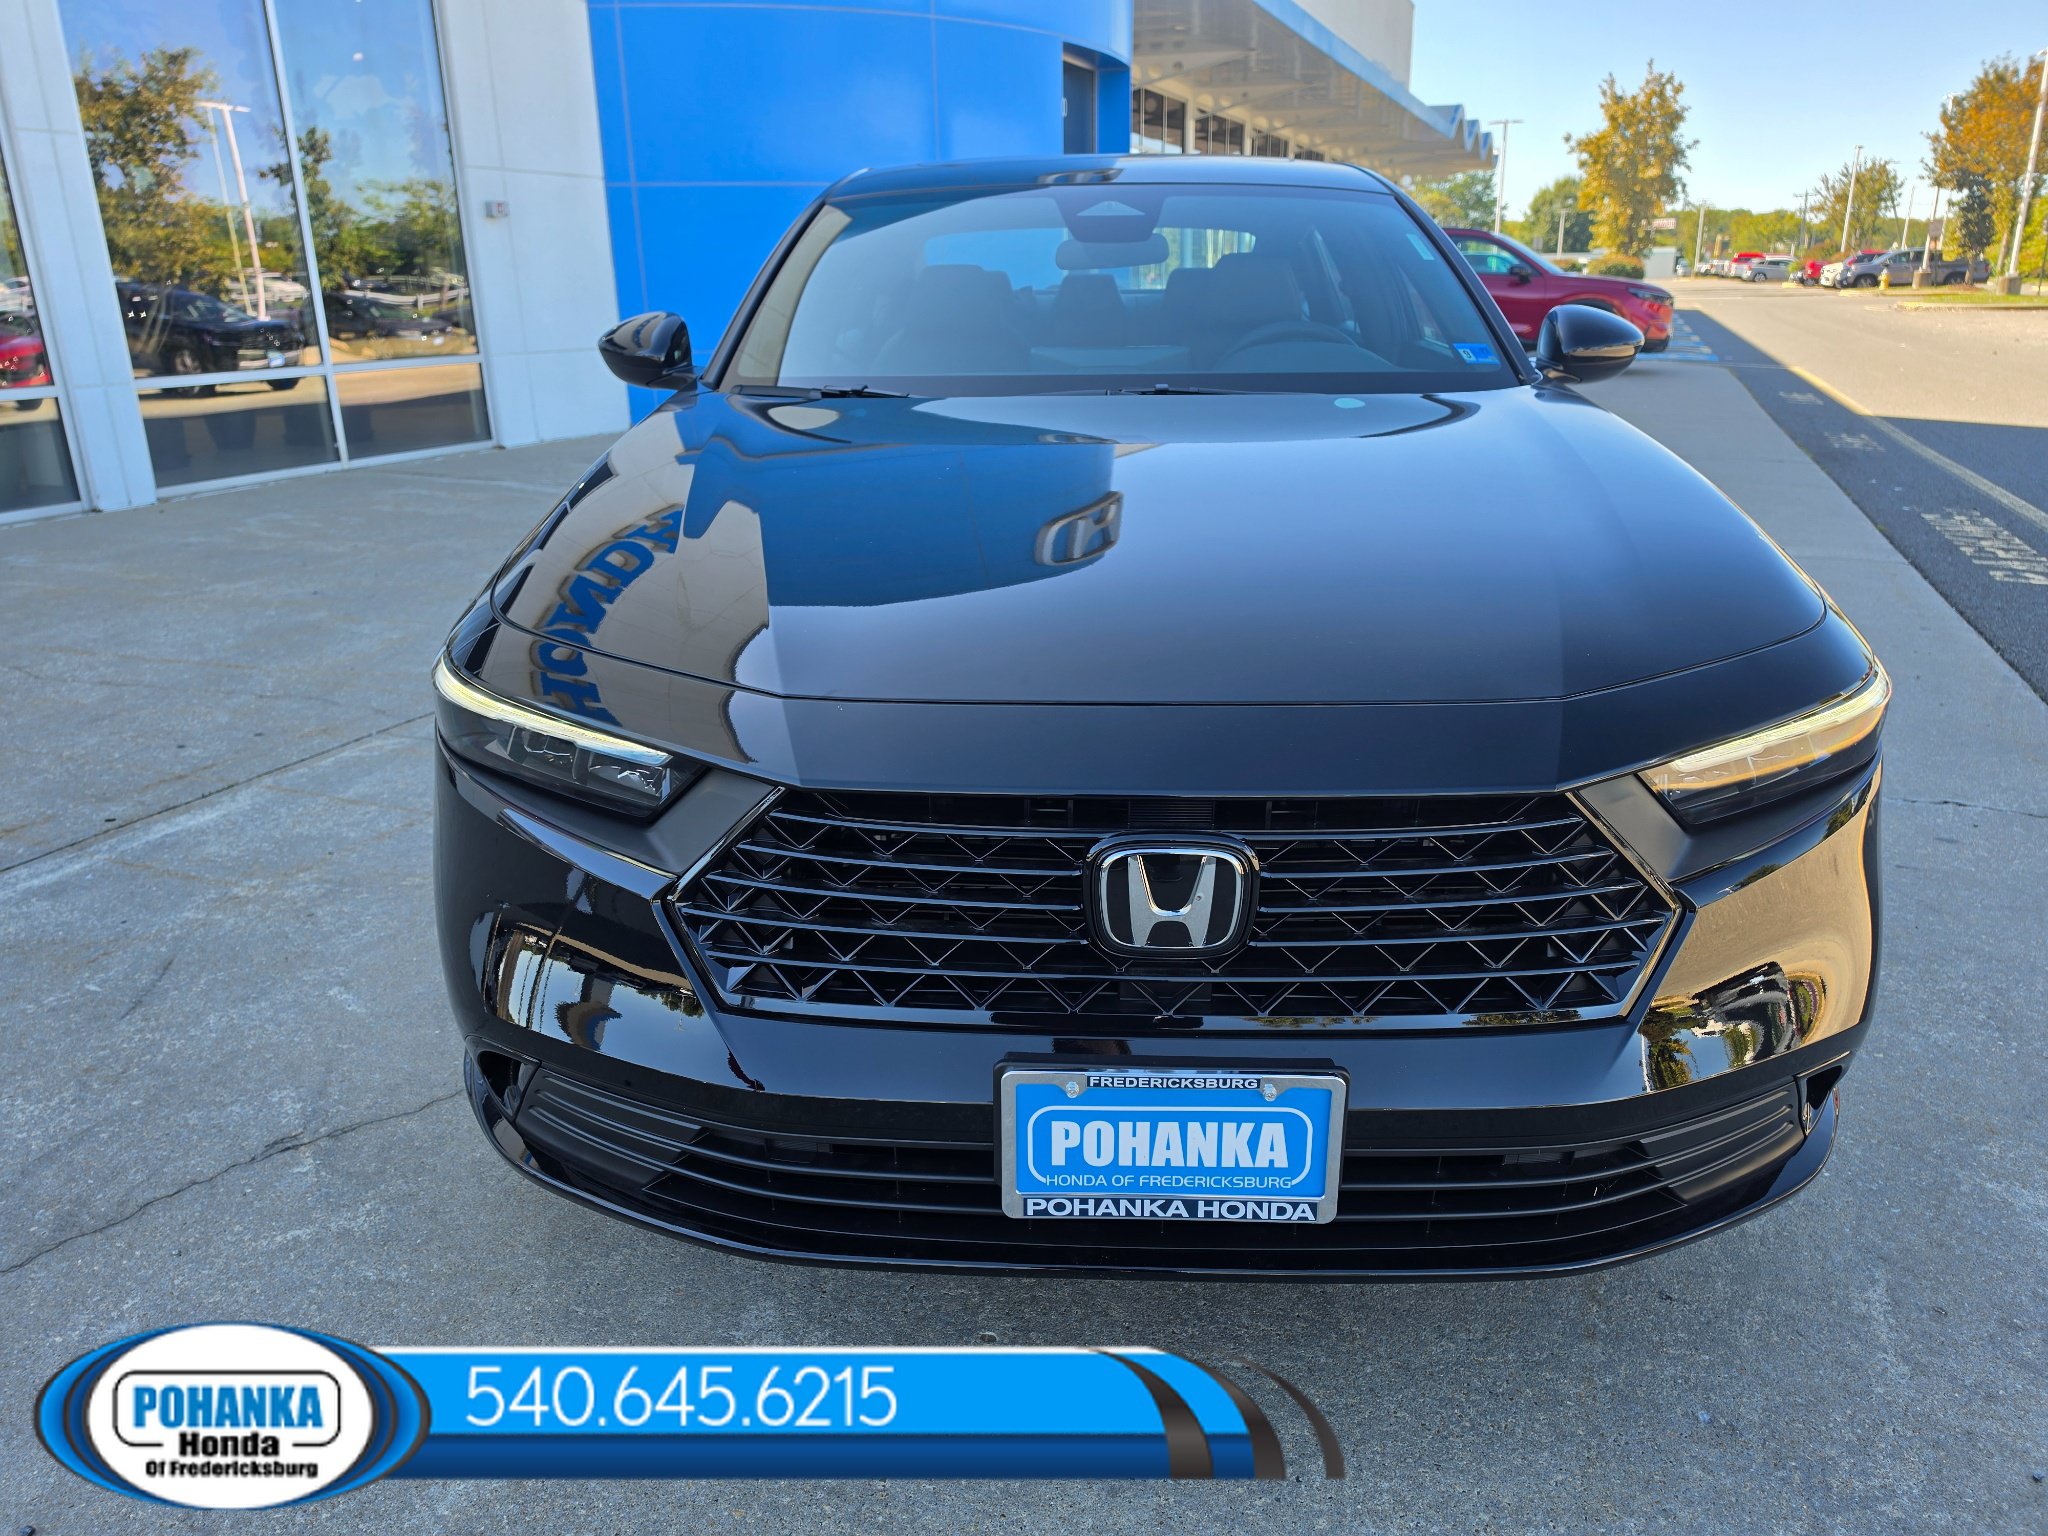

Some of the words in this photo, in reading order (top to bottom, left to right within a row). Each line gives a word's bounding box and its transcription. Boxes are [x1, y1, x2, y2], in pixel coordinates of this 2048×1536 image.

[1088, 1076, 1259, 1089] FREDERICKSBURG
[1050, 1119, 1289, 1168] POHANKA
[1045, 1174, 1108, 1188] HONDA
[1111, 1175, 1135, 1188] OF
[1139, 1175, 1293, 1189] FREDERICKSBURG
[1026, 1198, 1190, 1218] POHANKA
[1196, 1200, 1316, 1221] HONDA
